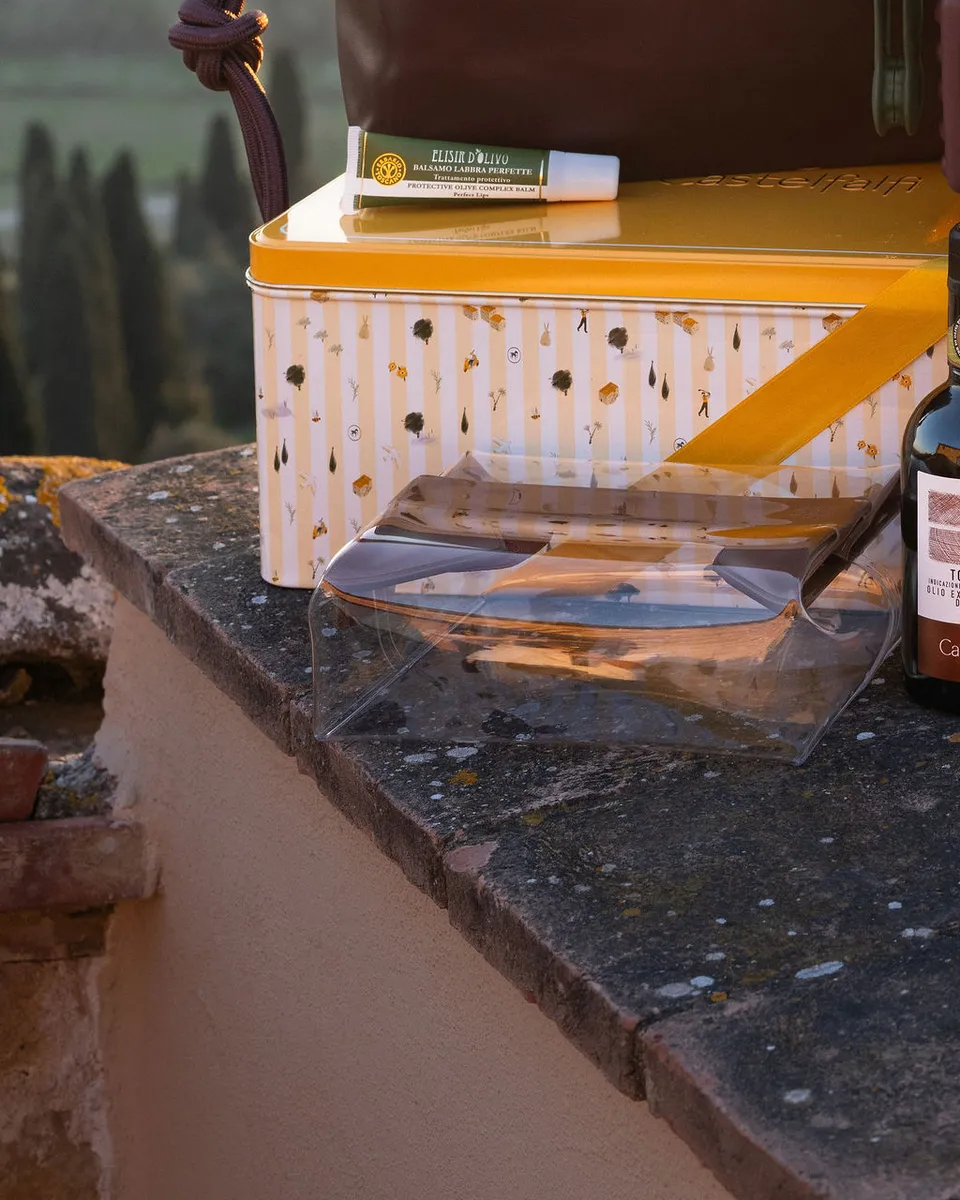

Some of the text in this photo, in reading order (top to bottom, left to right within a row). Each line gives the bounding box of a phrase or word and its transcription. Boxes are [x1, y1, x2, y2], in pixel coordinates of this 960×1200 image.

[431, 150, 465, 163] ELISIR
[413, 164, 533, 176] BALSAMO LABBRA PERFETTE
[375, 171, 402, 185] TOSCANO
[433, 174, 511, 184] Trattamento protettivo
[407, 183, 453, 191] PROTECTIVE
[478, 184, 514, 192] COMPLEX
[926, 585, 946, 597] OLIO
